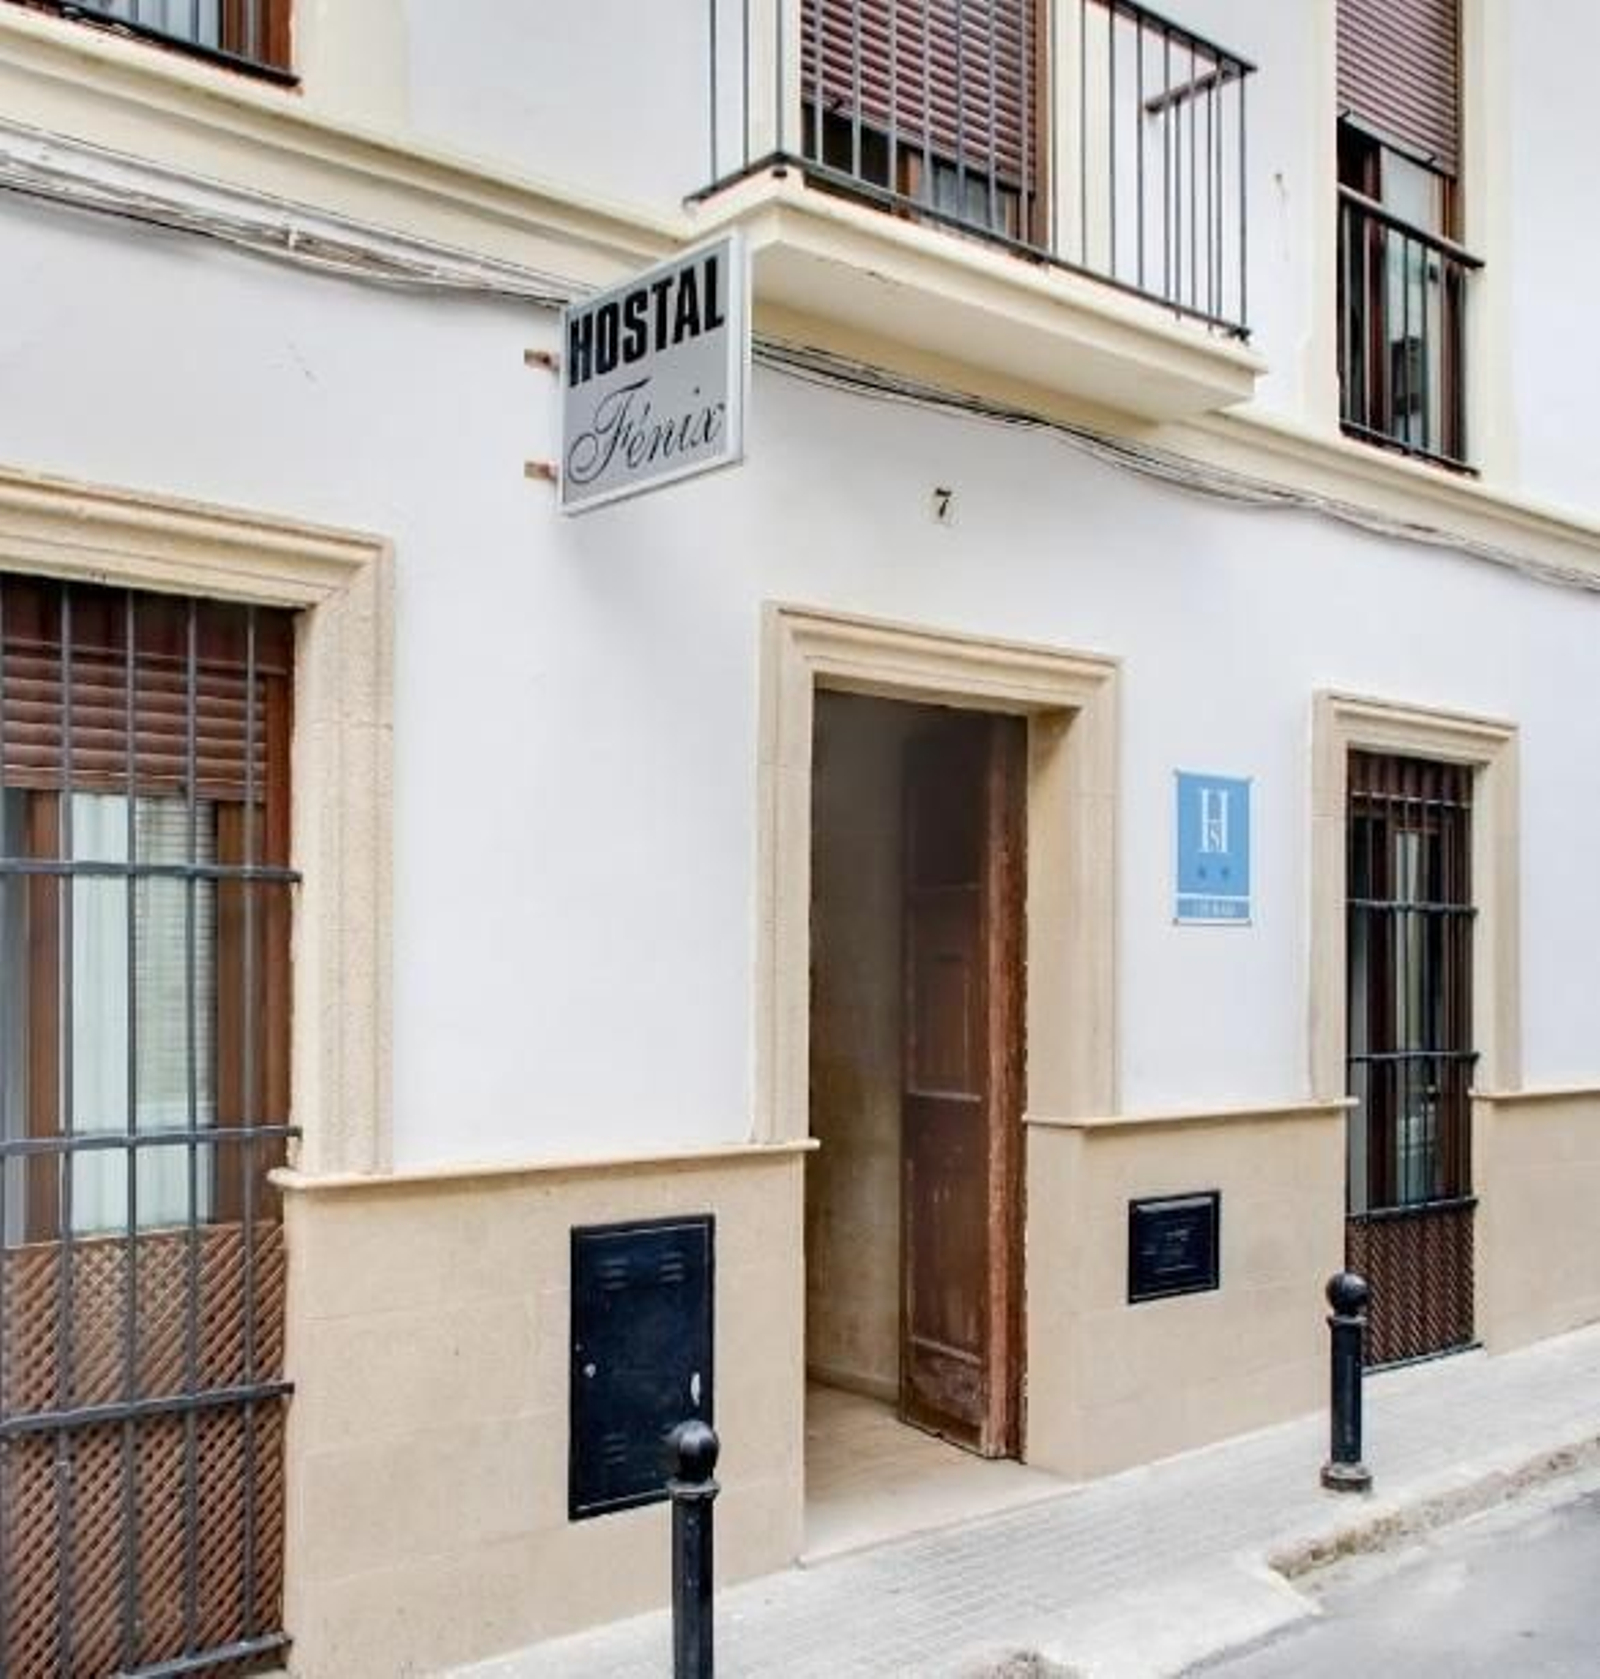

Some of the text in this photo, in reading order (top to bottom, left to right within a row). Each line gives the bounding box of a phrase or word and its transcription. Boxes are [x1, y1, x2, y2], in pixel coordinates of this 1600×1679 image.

[569, 255, 725, 388] HOSTAL
[568, 377, 726, 484] Fénix
[935, 487, 952, 519] 7
